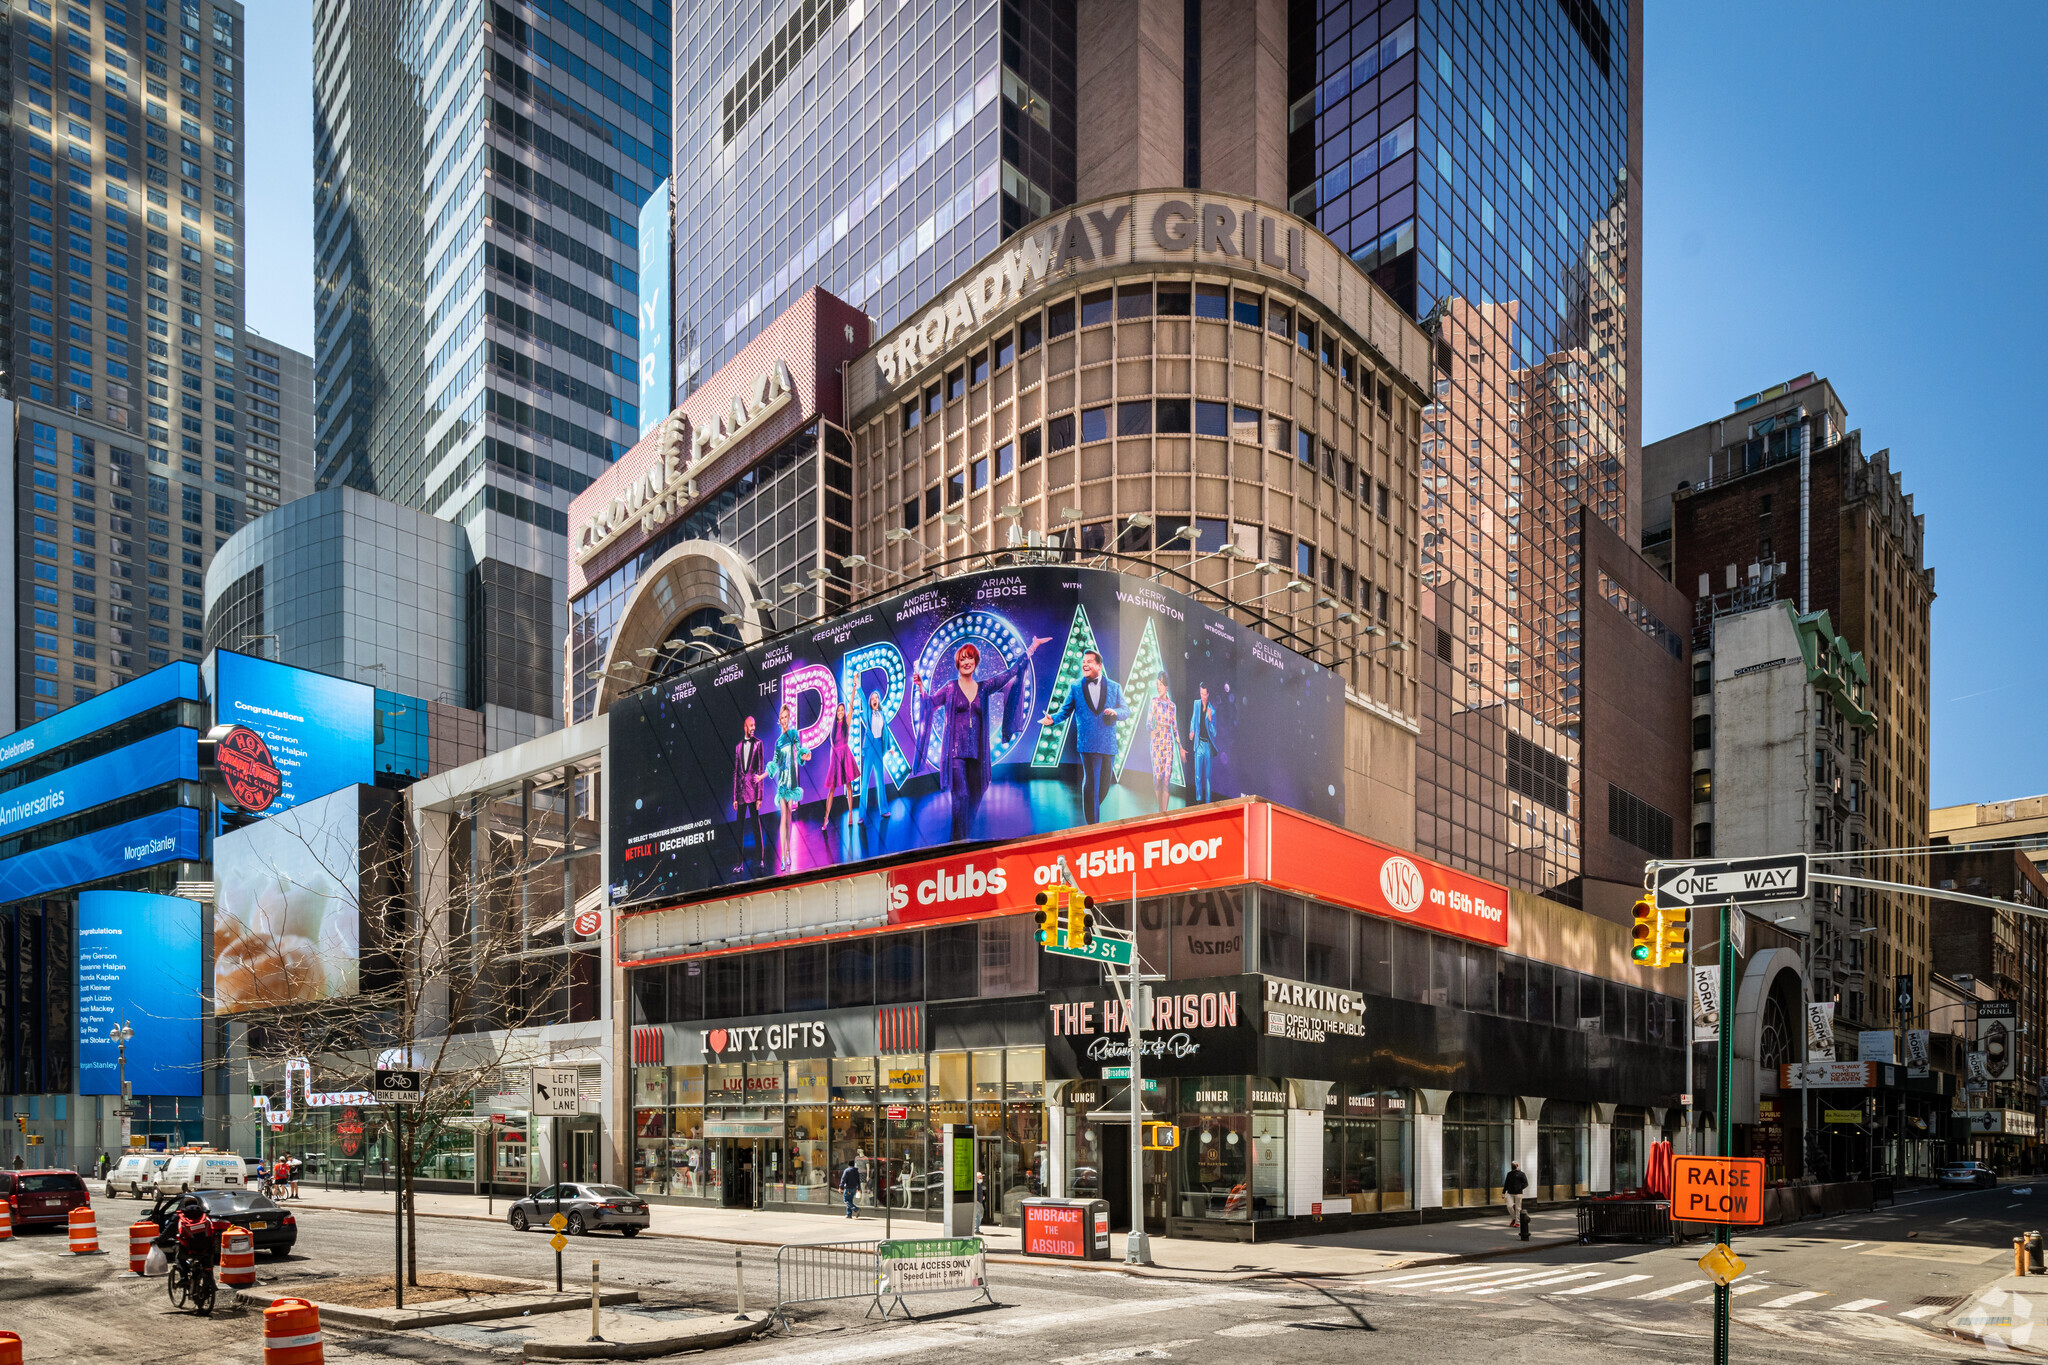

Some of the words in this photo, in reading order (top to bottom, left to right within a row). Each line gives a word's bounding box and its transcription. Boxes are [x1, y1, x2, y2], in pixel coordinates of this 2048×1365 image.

[876, 204, 1130, 384] BROADWAY
[1152, 200, 1309, 282] GRILL
[575, 446, 680, 553] CROWNE
[692, 358, 791, 463] PLAZA
[641, 478, 700, 534] HOTEL
[982, 576, 1022, 590] ARIANA
[903, 590, 939, 610] ANDREW
[976, 585, 1027, 600] DEBOSE
[1138, 587, 1167, 602] KERRY
[896, 597, 947, 622] RANNELLS
[1116, 591, 1185, 622] WASHINGTON
[813, 614, 874, 642] KEEGAN-MICHAEL
[1204, 625, 1235, 642] INTRODUCING
[1214, 622, 1224, 631] AND
[834, 631, 851, 644] KEY
[765, 645, 789, 660] NICOLE
[1255, 640, 1264, 650] JO
[1264, 643, 1282, 659] ELLEN
[762, 653, 793, 670] KIDMAN
[1252, 647, 1284, 670] PELLMAN
[714, 670, 744, 687] CORDEN
[719, 663, 739, 677] JAMES
[671, 687, 697, 702] STREEP
[675, 681, 693, 693] MERYL
[758, 678, 778, 696] THE
[234, 700, 305, 723] Congratulations
[235, 735, 263, 756] HOT
[267, 731, 299, 744] Gerson
[0, 738, 35, 762] Celebrates
[281, 745, 308, 758] Halpin
[272, 755, 301, 767] Kaplan
[220, 764, 252, 784] ORIGINAL
[254, 780, 278, 794] GLAZED
[235, 781, 265, 805] NOW
[0, 789, 65, 826] Anniversaries
[632, 834, 648, 844] SELECT
[648, 829, 670, 840] THEATERS
[670, 823, 694, 834] DECEMBER
[693, 820, 703, 829] AND
[703, 818, 712, 826] ON
[124, 844, 150, 861] Morgan
[149, 835, 176, 854] Stanley
[625, 843, 652, 861] NETFLIX
[660, 832, 705, 852] DECEMBER
[706, 829, 715, 841] 11
[917, 864, 1008, 905] clubs
[1033, 862, 1062, 887] on
[1077, 845, 1136, 878] 15th
[1144, 836, 1223, 871] Floor
[1675, 876, 1718, 894] ONE
[1743, 868, 1792, 889] WAY
[1384, 860, 1422, 911] NYSC
[1430, 888, 1446, 905] on
[1447, 888, 1473, 914] 15th
[1474, 897, 1502, 924] Floor
[1078, 940, 1097, 954] 9
[1101, 943, 1117, 958] St
[102, 963, 126, 971] Halpin
[96, 974, 120, 982] Kaplan
[1267, 980, 1350, 1014] PARKING
[90, 1005, 115, 1014] Mackey
[1050, 1001, 1094, 1036] THE
[1104, 990, 1237, 1033] HARISON
[1286, 1013, 1309, 1029] OPEN
[1310, 1018, 1321, 1031] TO
[1322, 1019, 1337, 1033] THE
[1338, 1022, 1365, 1037] PUBLIC
[700, 1030, 709, 1054] I
[766, 1021, 825, 1050] GIFTS
[1286, 1026, 1296, 1038] 24
[1297, 1027, 1325, 1042] HOURS
[1167, 1032, 1200, 1059] Bar
[93, 1061, 117, 1070] Stanley
[552, 1075, 574, 1084] LEFT
[723, 1077, 779, 1091] LUGGAGE
[857, 1075, 871, 1085] NY
[377, 1092, 394, 1100] BIKE
[397, 1092, 418, 1101] LANE
[552, 1087, 576, 1097] TURN
[1070, 1093, 1095, 1103] LUNCH
[1195, 1091, 1228, 1102] DINNER
[1252, 1090, 1286, 1103] BREAKFAST
[553, 1101, 576, 1110] LANE
[1327, 1094, 1337, 1106] NCH
[1348, 1096, 1375, 1108] COCKTAILS
[1388, 1098, 1406, 1109] DINNER
[1688, 1167, 1750, 1187] RAISE
[1690, 1193, 1748, 1214] PLOW
[1028, 1208, 1078, 1223] EMBRACE
[1044, 1225, 1059, 1235] THE
[1032, 1239, 1075, 1255] ABSURD
[893, 1262, 918, 1271] LOCAL
[921, 1261, 951, 1270] ACCESS
[952, 1259, 971, 1268] ONLY
[903, 1272, 924, 1280] Speed
[925, 1271, 941, 1279] Limit
[949, 1270, 963, 1278] MPH
